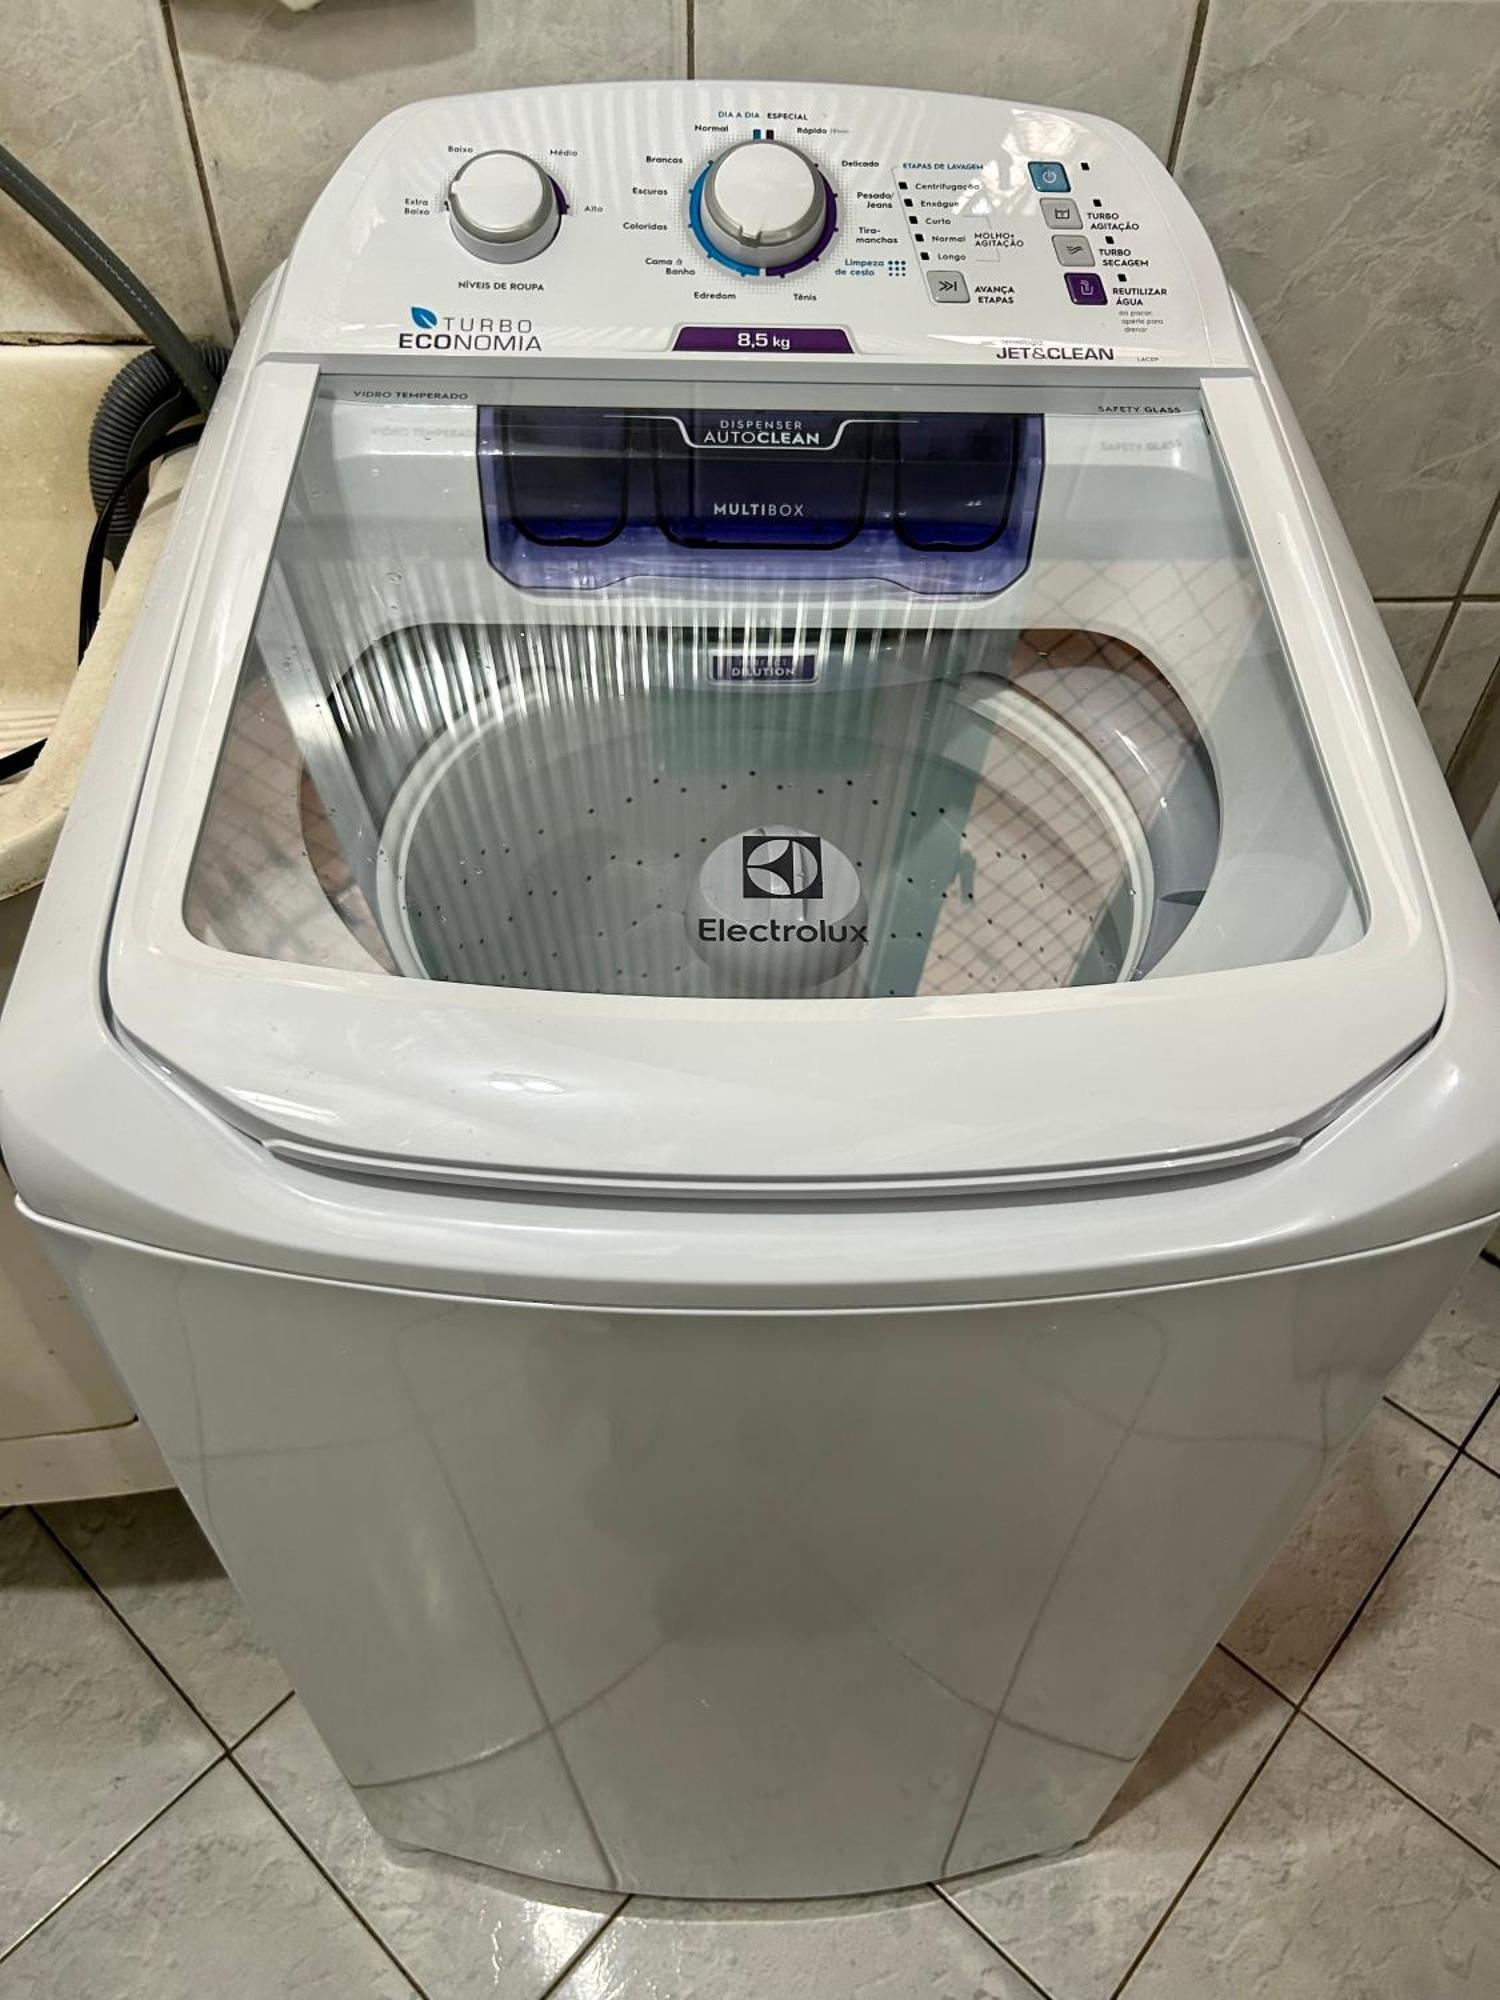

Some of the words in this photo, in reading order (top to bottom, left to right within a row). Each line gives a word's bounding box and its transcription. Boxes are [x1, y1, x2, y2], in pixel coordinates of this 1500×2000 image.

[718, 111, 734, 119] DIA
[767, 112, 809, 121] ESPECIAL
[694, 124, 729, 132] Normal
[797, 127, 828, 135] Rápido
[448, 145, 474, 154] Baixo
[550, 149, 578, 157] Médio
[645, 156, 683, 164] Brancas
[841, 160, 880, 168] Delicado
[902, 162, 932, 170] ETAPAS
[632, 187, 668, 196] Escuras
[856, 191, 895, 200] Pesado/
[404, 198, 429, 206] Extra
[404, 207, 430, 216] Baixo
[584, 205, 604, 213] Alto
[1087, 212, 1120, 220] TURBO
[623, 222, 668, 231] Coloridas
[1090, 221, 1140, 232] AGITAÇÃO
[855, 236, 898, 244] manchas
[975, 240, 1025, 248] AGITAÇÃO
[1098, 248, 1132, 257] TURBO
[645, 257, 673, 265] Cama
[938, 253, 967, 262] Longo
[844, 258, 885, 268] Limpeza
[1102, 259, 1149, 267] SECAGEM
[665, 268, 696, 276] Banho
[849, 268, 875, 276] cesto
[458, 280, 491, 290] NÍVEIS
[493, 282, 507, 290] DE
[510, 282, 544, 291] ROUPA
[974, 286, 1015, 294] AVANÇA
[693, 291, 737, 300] Edredom
[1112, 287, 1168, 296] REUTILIZAR
[793, 293, 817, 301] Tênis
[978, 296, 1014, 305] ETAPAS
[1115, 297, 1144, 306] ÁGUA
[442, 317, 532, 334] TURBO
[399, 333, 543, 352] ECONOMIA
[738, 332, 769, 348] 8,5
[772, 336, 790, 350] kg
[996, 347, 1115, 361] JET&CLEAN
[353, 390, 392, 399] VIDRO
[395, 391, 469, 400] TEMPERADO
[1098, 405, 1140, 413] SAFETY
[1144, 406, 1182, 414] GLASS
[720, 419, 803, 430] DISPENSER
[703, 430, 820, 446] AUTOCLEAN
[713, 503, 804, 517] MULTIBOX
[732, 667, 796, 677] DILUTION
[699, 918, 869, 944] Electrolux
